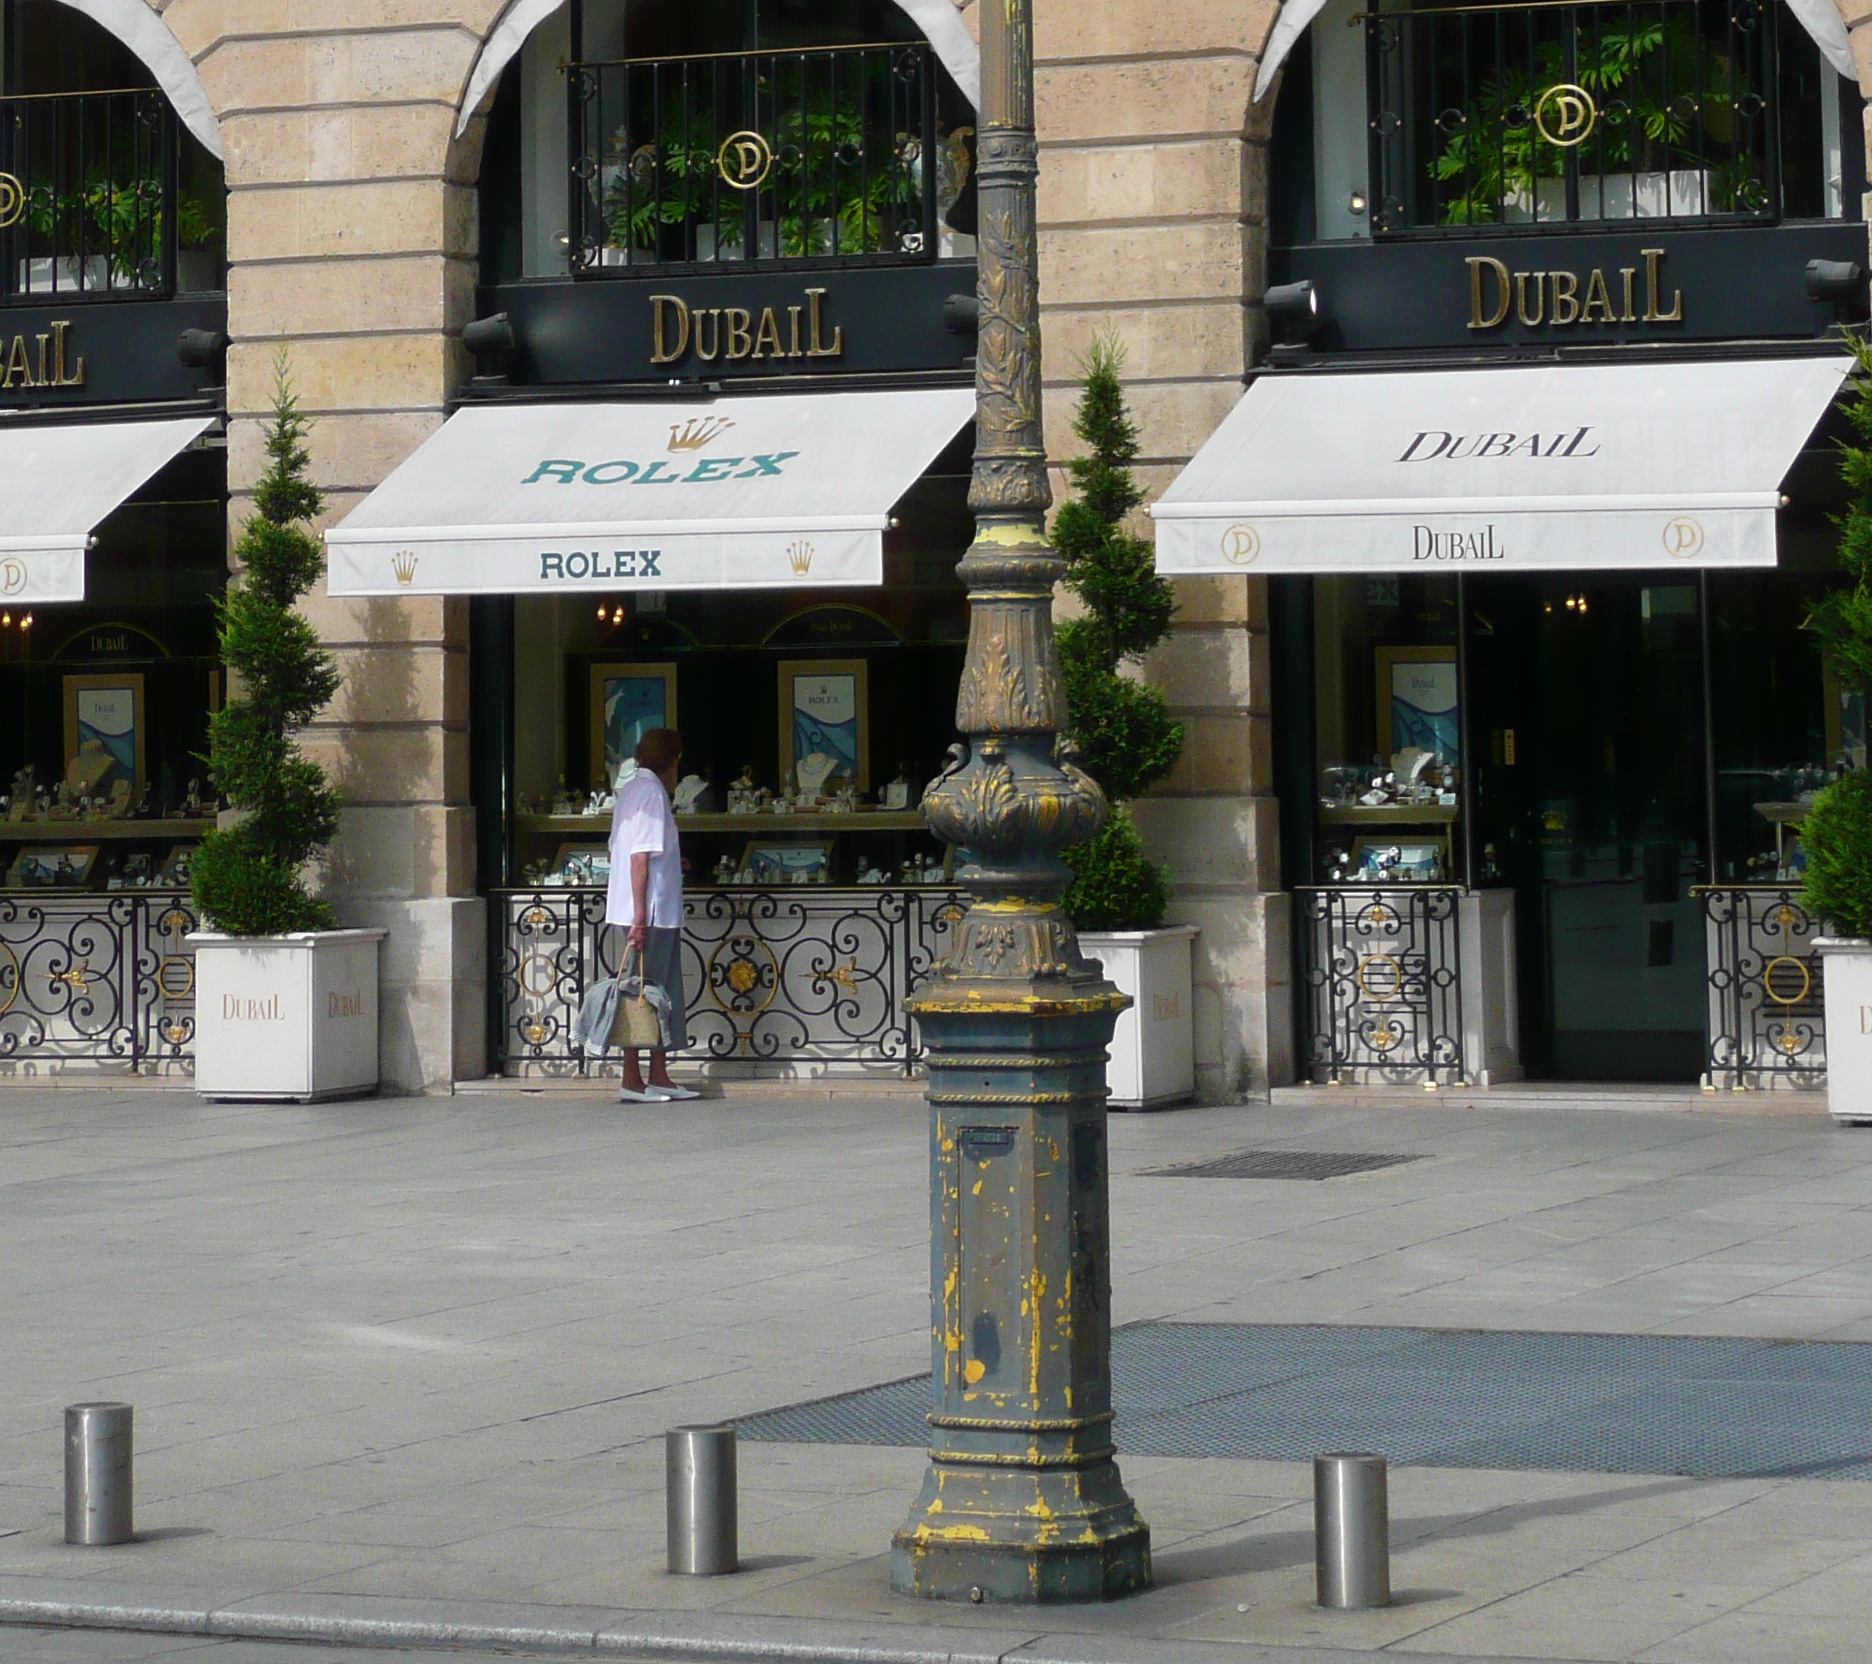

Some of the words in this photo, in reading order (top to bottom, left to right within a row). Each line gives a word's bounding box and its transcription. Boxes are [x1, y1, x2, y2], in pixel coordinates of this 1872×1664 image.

[1464, 248, 1682, 329] DUBAIL
[649, 287, 842, 364] DUBAIL
[0, 320, 84, 387] AIL
[1394, 426, 1601, 463] DUBAIL
[520, 450, 800, 485] ROLEX
[1412, 524, 1505, 560] DUBAIL
[540, 550, 661, 579] ROLEX
[222, 993, 286, 1020] DUBAIL
